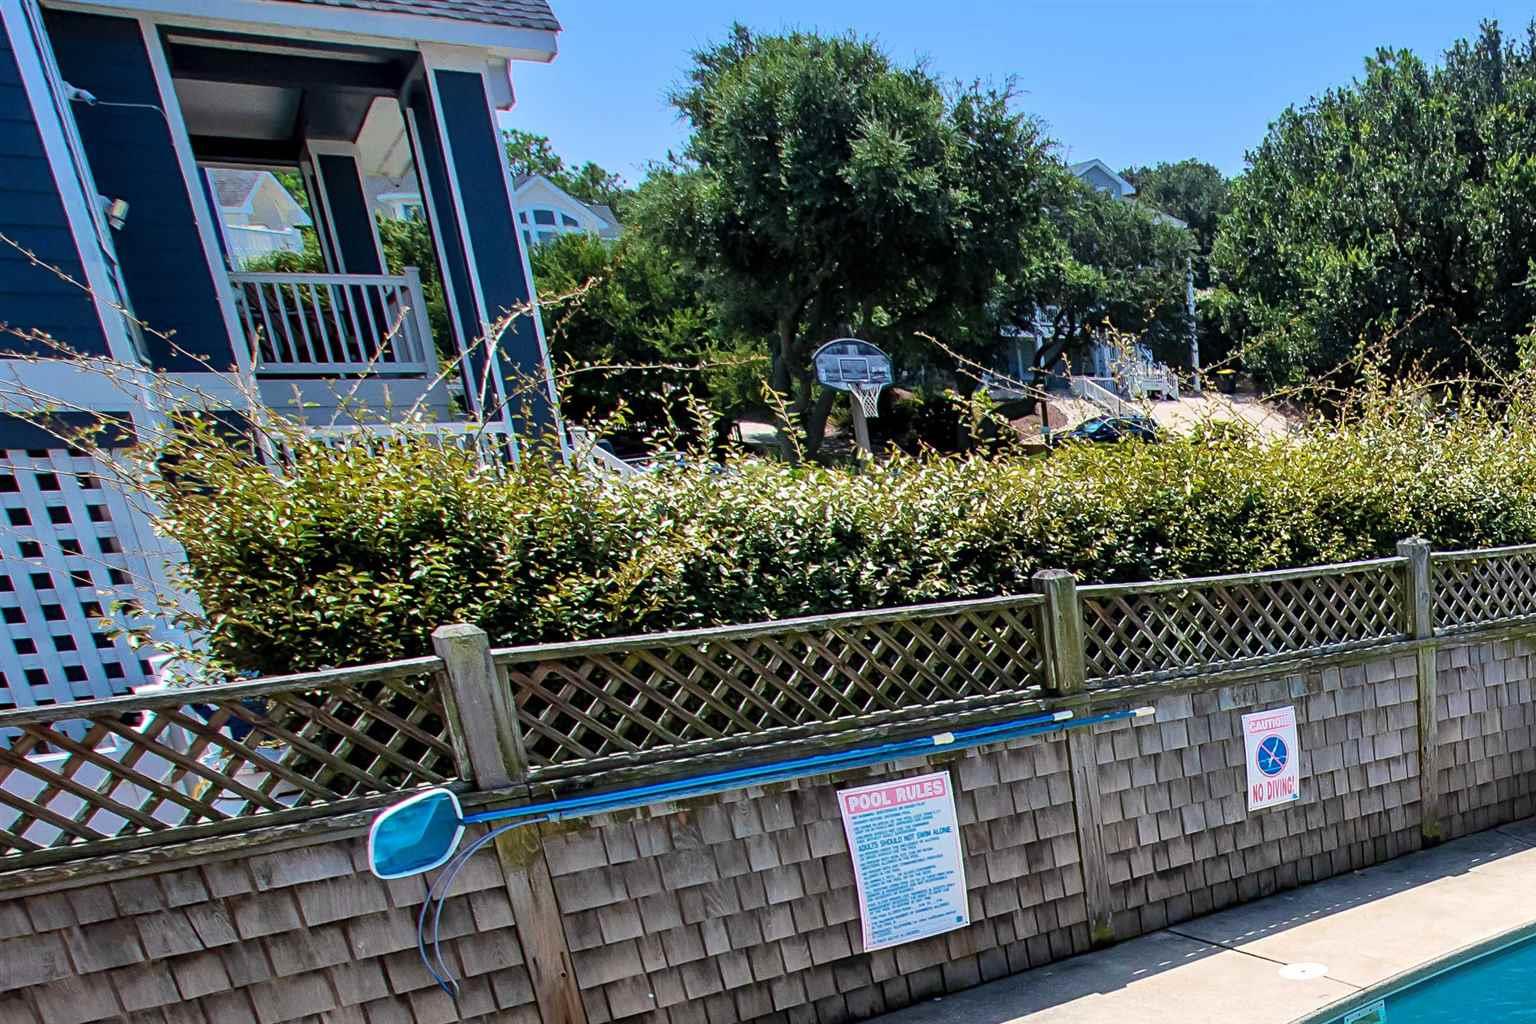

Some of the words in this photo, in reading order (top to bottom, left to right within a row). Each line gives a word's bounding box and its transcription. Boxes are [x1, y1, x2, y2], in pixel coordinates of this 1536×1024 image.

[848, 792, 892, 812] POOL
[896, 780, 945, 801] RULES
[1253, 784, 1264, 803] NO
[1267, 776, 1295, 801] DIVING!
[880, 836, 902, 848] SHOULD
[932, 825, 953, 837] ALONE
